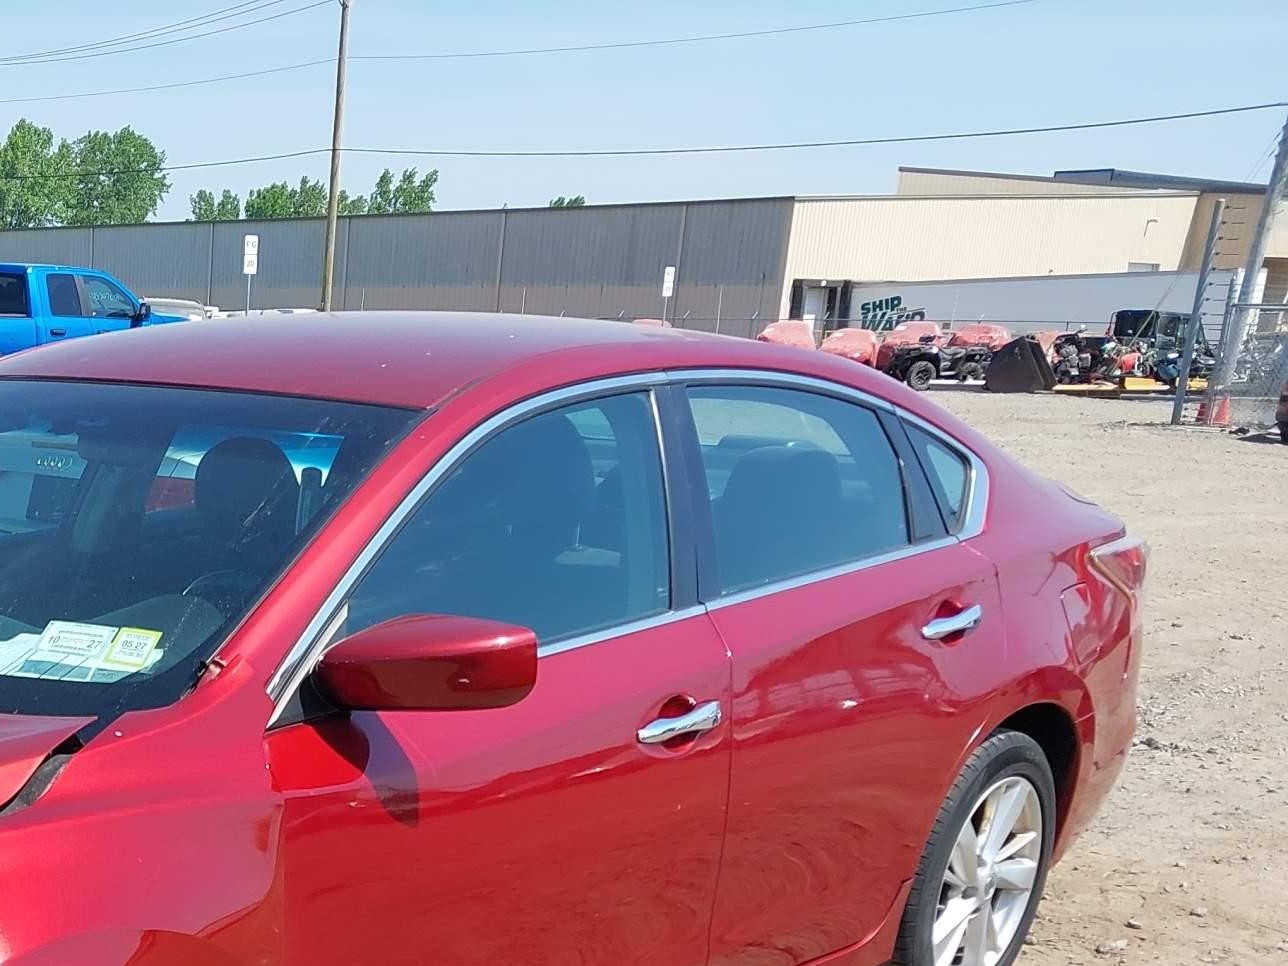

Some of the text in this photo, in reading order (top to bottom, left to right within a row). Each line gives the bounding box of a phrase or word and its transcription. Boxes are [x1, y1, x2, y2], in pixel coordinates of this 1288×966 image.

[861, 296, 902, 315] SHIP
[48, 635, 61, 644] 10
[87, 639, 103, 649] 27
[135, 641, 147, 650] 27
